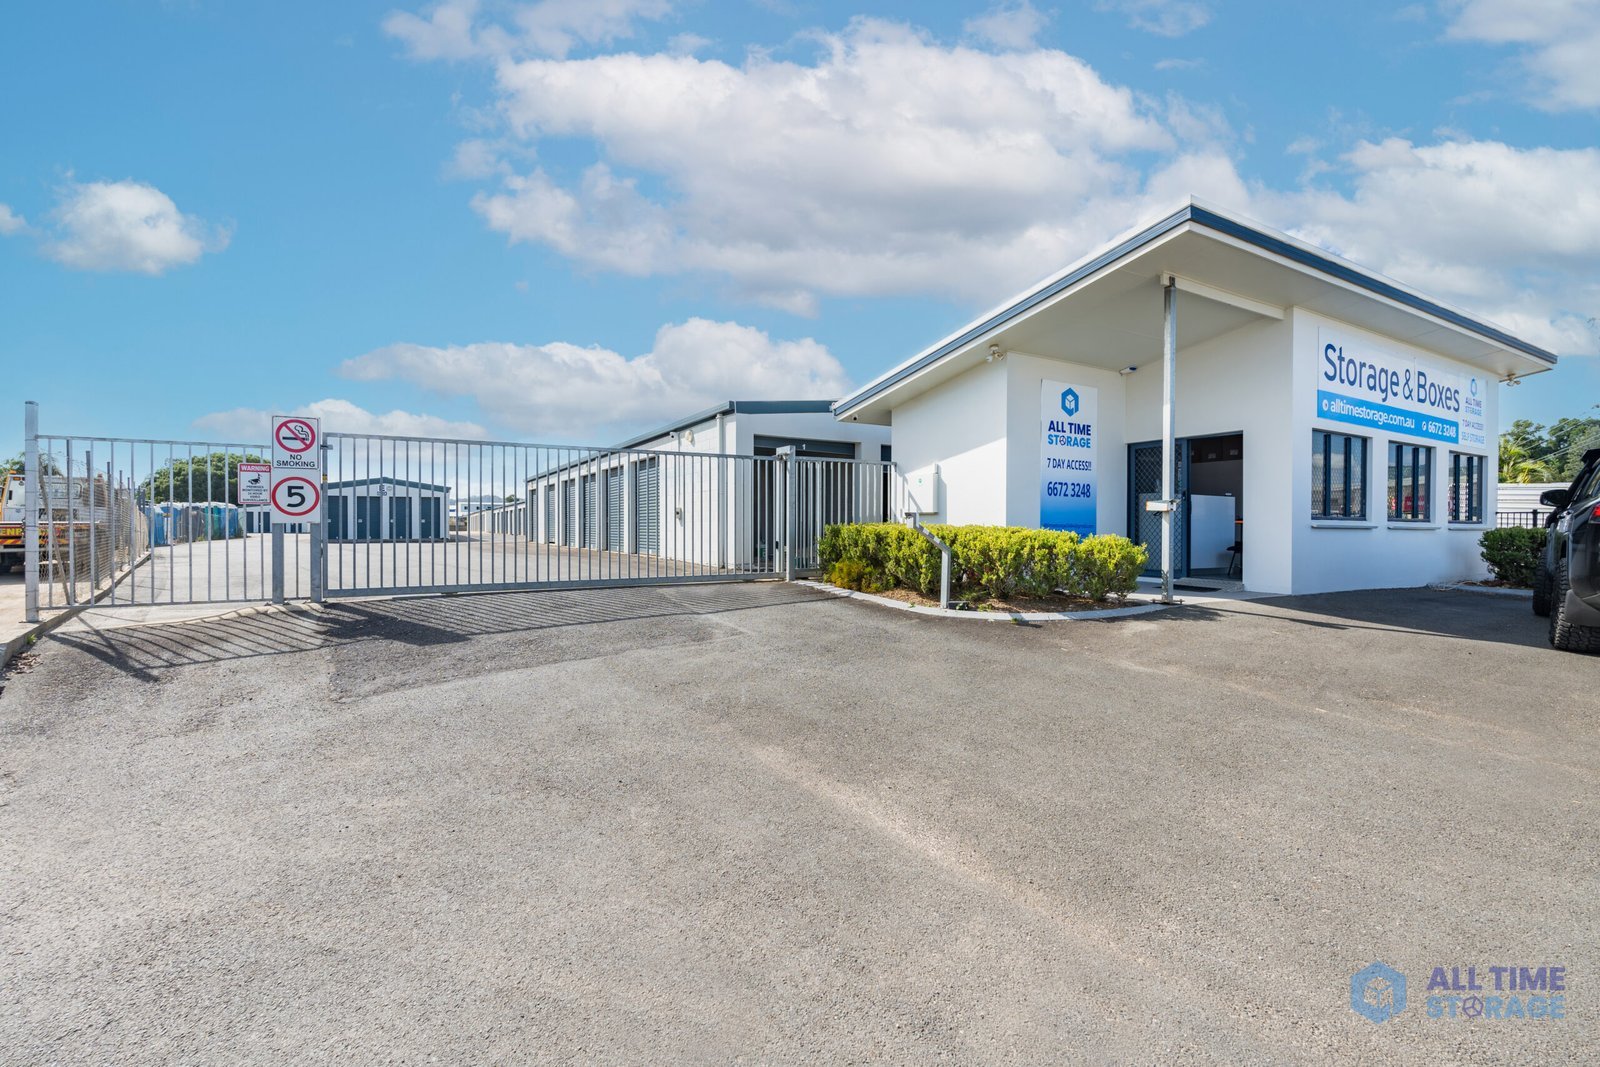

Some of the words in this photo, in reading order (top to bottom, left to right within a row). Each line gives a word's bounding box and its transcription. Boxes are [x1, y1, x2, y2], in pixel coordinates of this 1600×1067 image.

[1324, 343, 1400, 403] Storage
[1402, 368, 1414, 402] &
[1416, 370, 1460, 413] Boxes
[1330, 399, 1415, 429] alltimestorage.com.au
[1428, 420, 1442, 435] 6672
[1443, 424, 1457, 438] 3248
[1048, 420, 1066, 433] ALL
[1068, 422, 1091, 436] TIME
[1048, 434, 1091, 448] STORAGE
[1047, 458, 1051, 468] 7
[1052, 458, 1065, 469] DAY
[287, 486, 305, 507] 5
[1047, 481, 1068, 497] 6672
[1070, 482, 1091, 498] 3248
